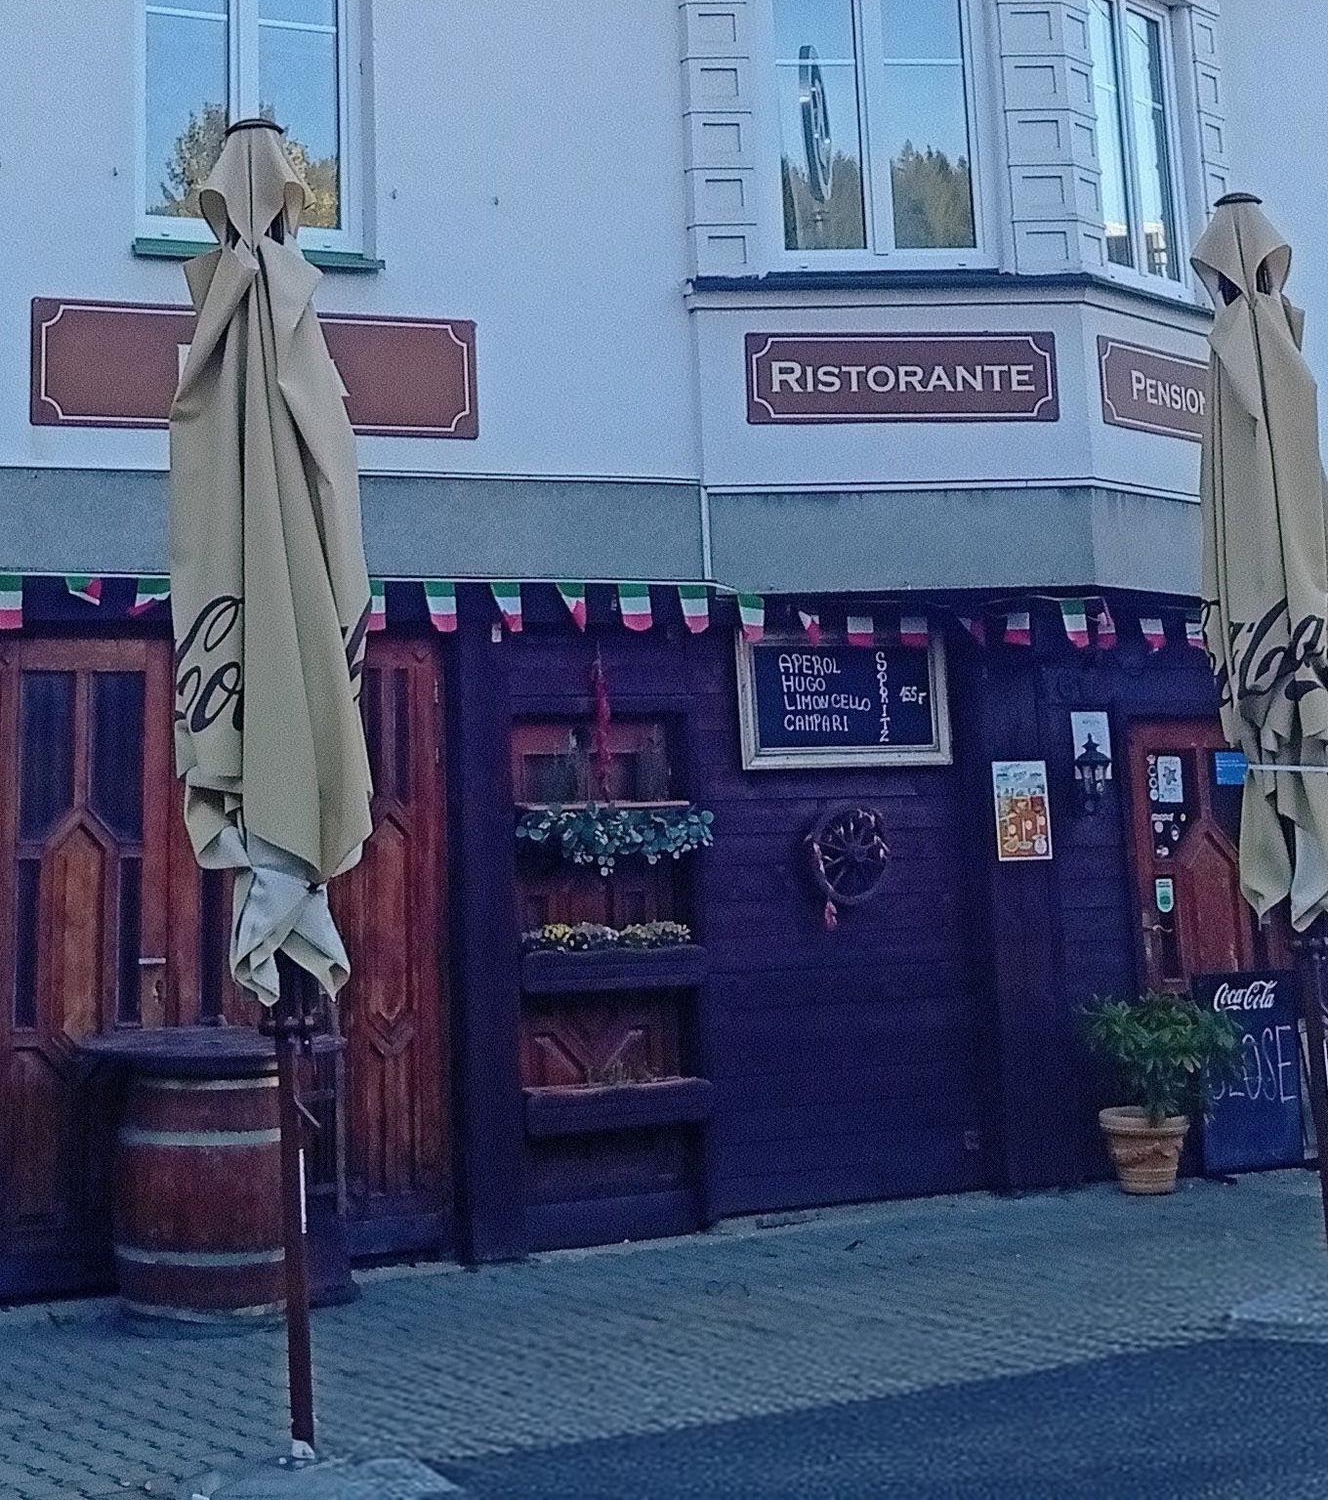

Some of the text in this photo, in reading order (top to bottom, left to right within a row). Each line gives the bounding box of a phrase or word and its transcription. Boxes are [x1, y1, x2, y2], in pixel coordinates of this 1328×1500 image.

[771, 361, 1036, 393] RISTORANTE
[778, 653, 841, 676] APEROL
[782, 675, 826, 692] HUGO
[784, 694, 871, 712] LIMONCELLO
[784, 714, 849, 732] CAMPARI
